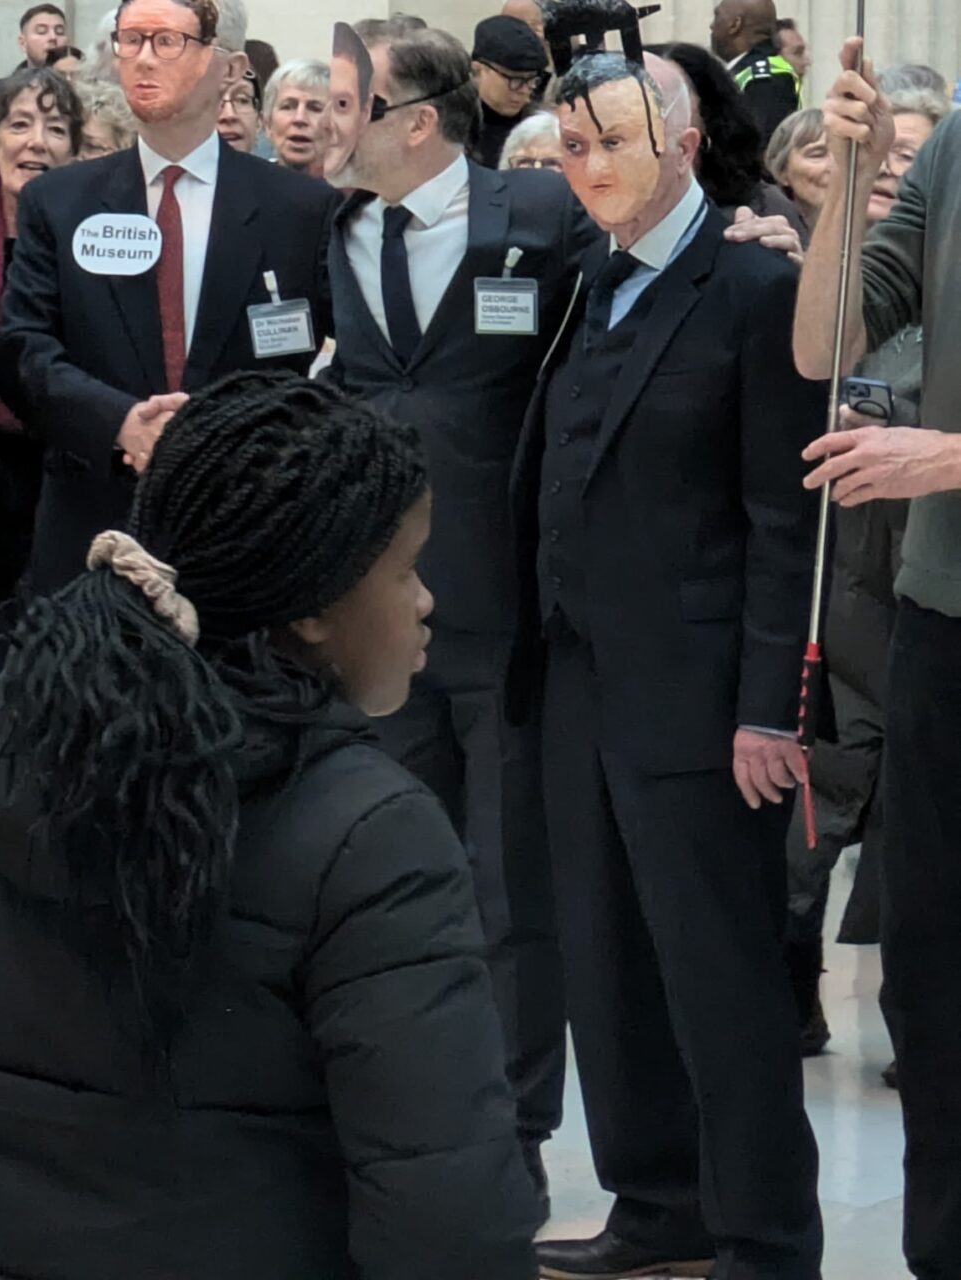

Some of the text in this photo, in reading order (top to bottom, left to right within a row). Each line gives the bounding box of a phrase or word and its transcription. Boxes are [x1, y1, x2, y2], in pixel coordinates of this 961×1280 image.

[79, 225, 158, 240] The British
[81, 243, 153, 260] Museum
[482, 295, 519, 303] GEORGE
